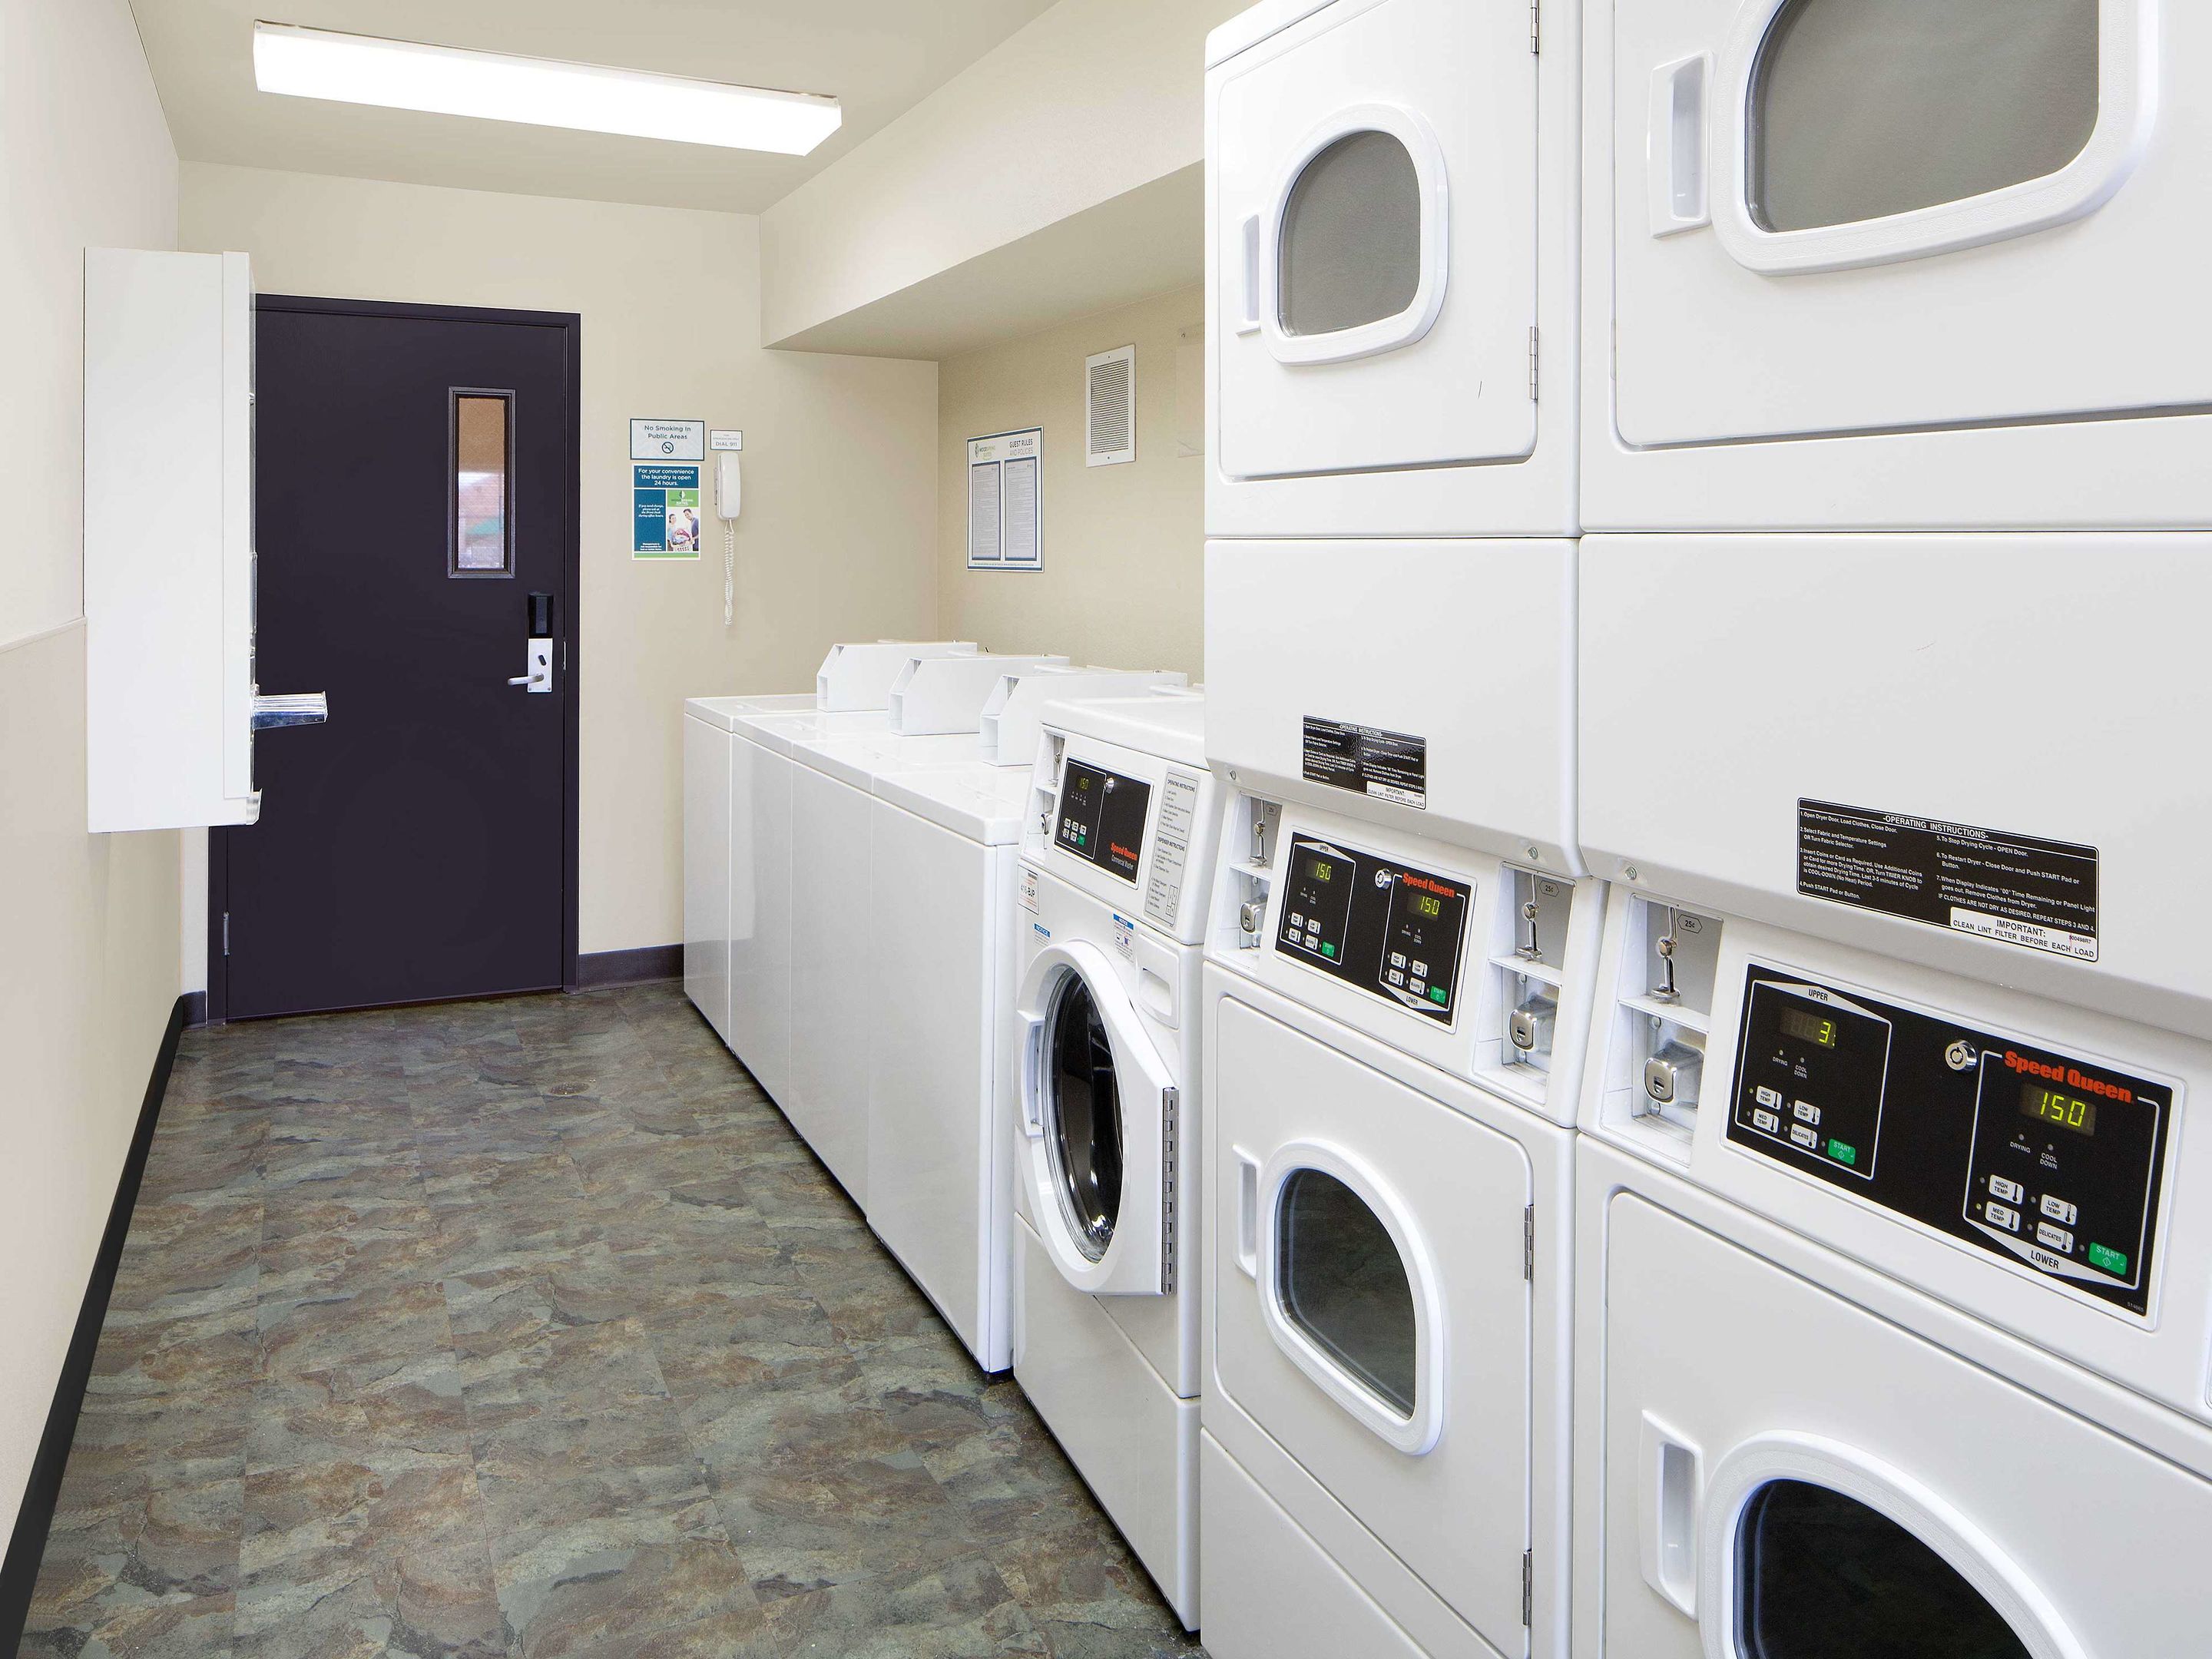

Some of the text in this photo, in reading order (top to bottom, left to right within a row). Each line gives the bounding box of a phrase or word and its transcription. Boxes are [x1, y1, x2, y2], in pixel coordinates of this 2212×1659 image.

[1840, 834, 1867, 844] Temperature
[1868, 839, 1886, 848] Settings
[1962, 839, 1978, 849] Drying
[1111, 843, 1137, 861] Speed Queen
[1316, 863, 1331, 880] 150
[2041, 872, 2059, 880] START
[1402, 873, 1455, 897] Speed Queen
[1956, 879, 1975, 889] Display
[1975, 883, 1998, 892] Indicates
[2026, 893, 2055, 906] Remaining
[2081, 905, 2095, 913] Light
[1965, 889, 1985, 898] Remove
[1987, 893, 2006, 902] Clothes
[1419, 896, 1440, 915] 150
[1944, 894, 1965, 904] CLOTHES
[2033, 914, 2053, 922] REPEAT
[1996, 919, 2045, 937] IMPORTANT:
[1953, 920, 1974, 929] CLEAN
[1995, 930, 2016, 939] FILTER
[2021, 935, 2048, 947] BEFORE
[2052, 942, 2071, 952] EACH
[2075, 947, 2094, 957] LOAD
[1406, 995, 1418, 1005] LOWER
[1808, 988, 1828, 1002] UPPER
[1773, 1057, 1788, 1066] DRYING
[1794, 1069, 1806, 1078] DOWN
[1795, 1065, 1806, 1074] COOL
[2005, 1050, 2133, 1104] Speed Queen
[1798, 1109, 1809, 1118] TEMP
[2040, 1091, 2086, 1128] 150
[1834, 1141, 1850, 1152] START
[2010, 1141, 2031, 1154] DRYING
[2040, 1158, 2058, 1170] DOWN
[2041, 1152, 2058, 1164] COOL
[1994, 1186, 2008, 1195] TEMP
[1995, 1180, 2008, 1189] HIGH
[1992, 1206, 2004, 1215] MED
[2048, 1200, 2061, 1208] LOW
[2046, 1206, 2061, 1216] TEMP
[1991, 1213, 2005, 1223] TEMP
[2039, 1228, 2061, 1242] DELICATES
[2096, 1245, 2120, 1260] START
[2031, 1250, 2059, 1270] LOWER
